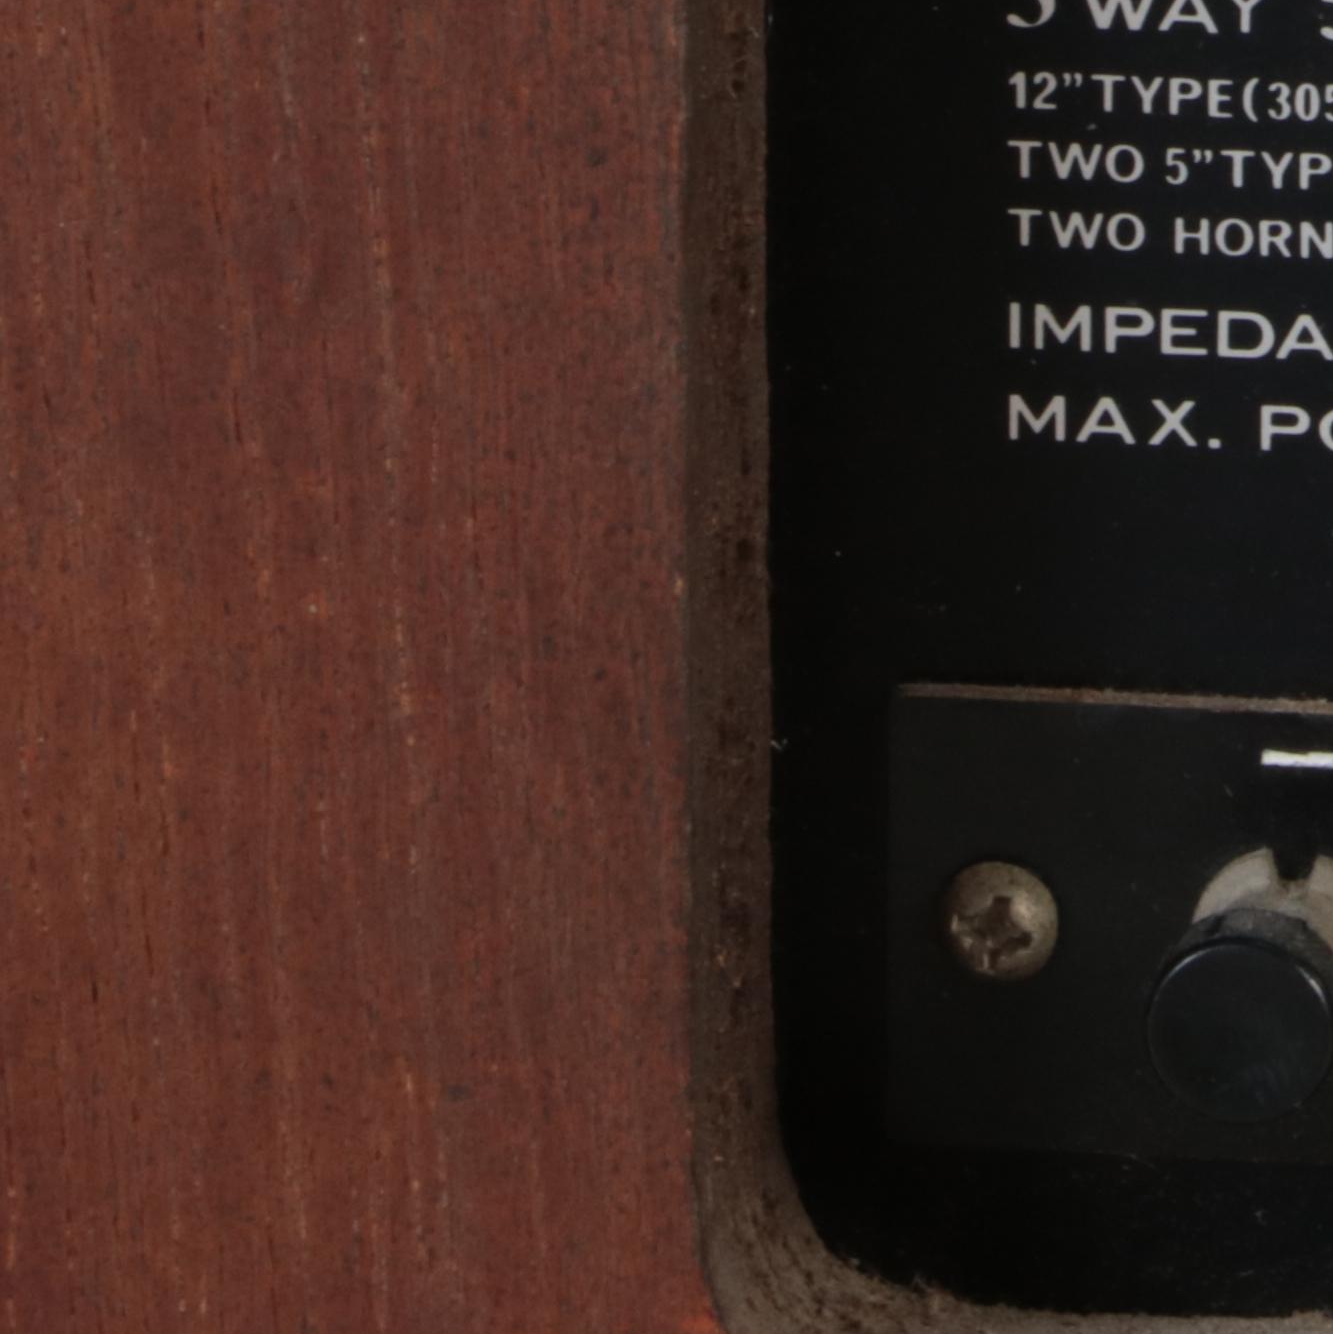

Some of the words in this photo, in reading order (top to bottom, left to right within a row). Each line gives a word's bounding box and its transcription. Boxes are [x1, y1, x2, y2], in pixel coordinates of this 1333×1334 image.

[1007, 140, 1145, 184] TWO
[1007, 208, 1146, 252] TWO
[1008, 394, 1222, 450] MAX.
